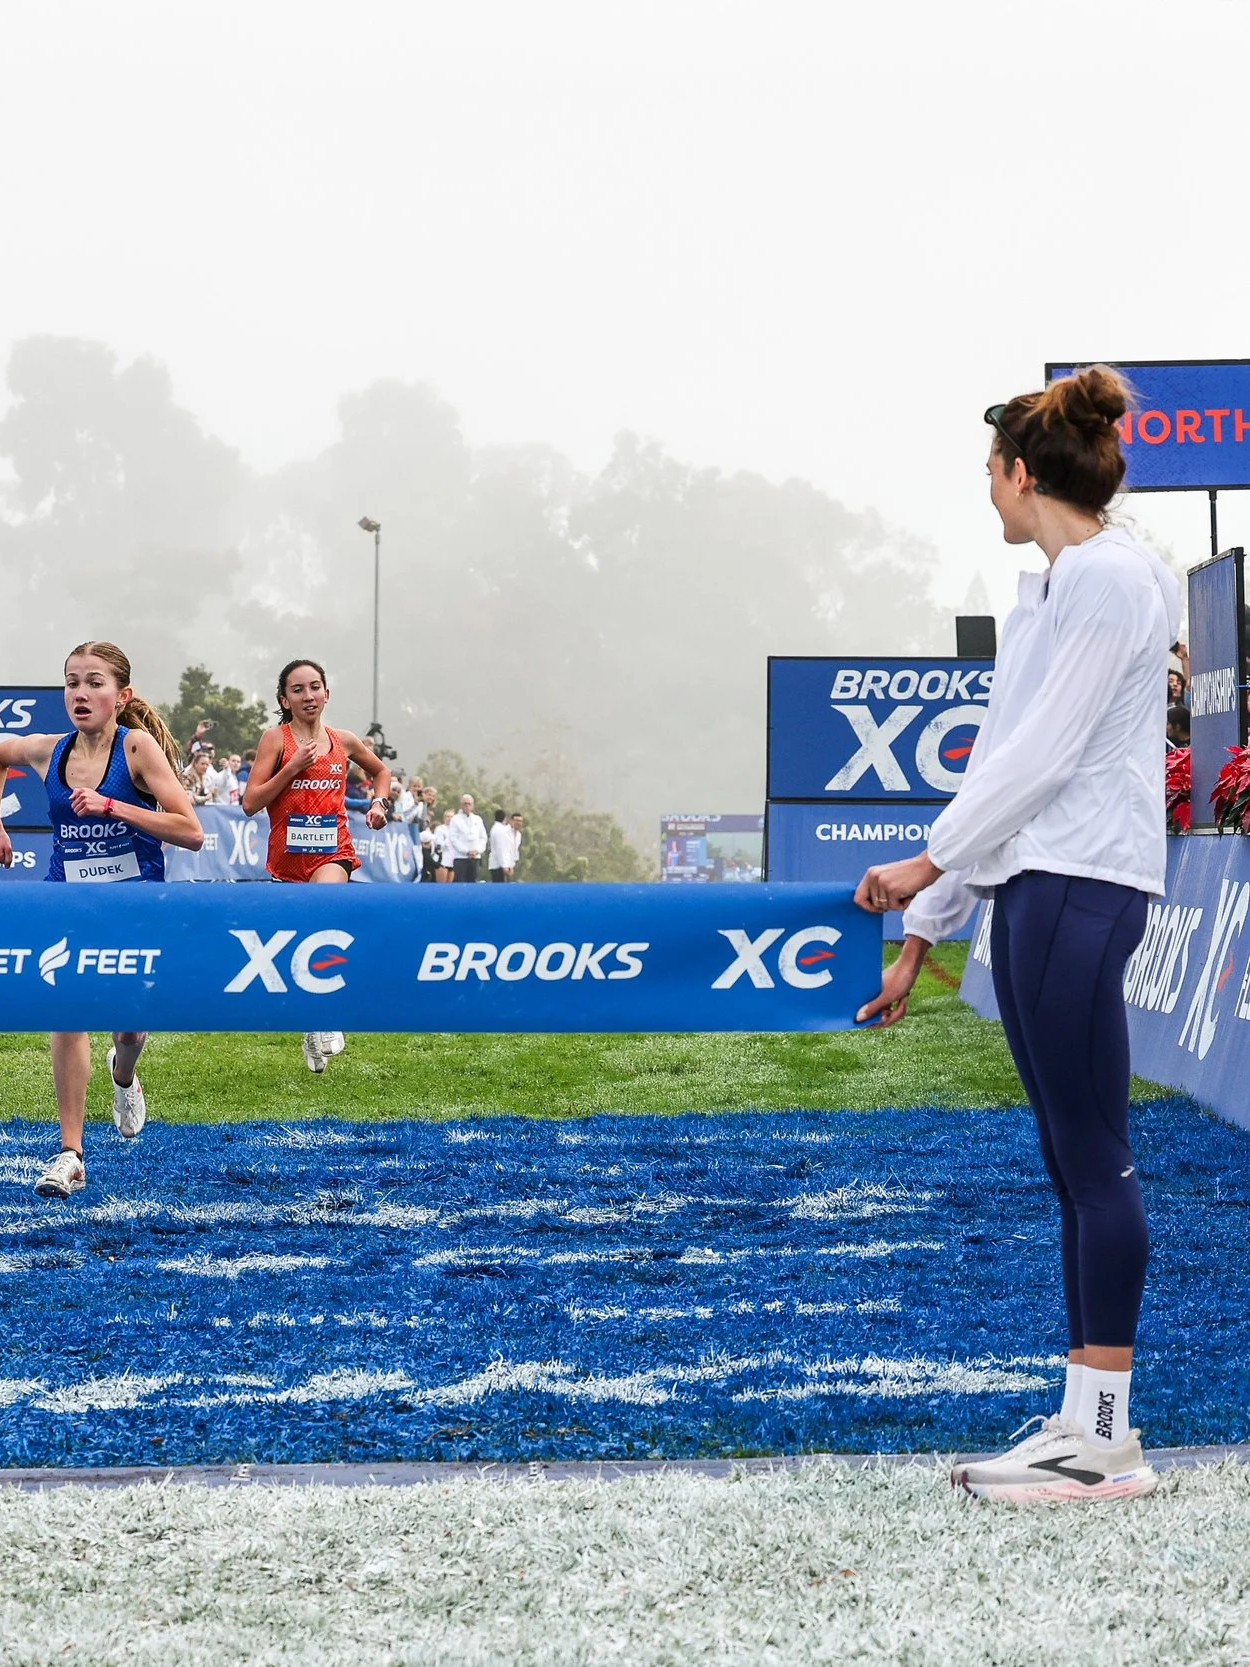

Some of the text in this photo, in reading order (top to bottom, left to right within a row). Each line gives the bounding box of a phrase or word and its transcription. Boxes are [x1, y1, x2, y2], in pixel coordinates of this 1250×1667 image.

[824, 704, 990, 793] XC
[291, 779, 342, 790] BROOKS
[60, 820, 128, 839] BROOKS
[305, 815, 322, 825] XC
[229, 820, 259, 865] XC
[291, 833, 334, 841] BARTLETT
[85, 841, 107, 854] XC
[79, 863, 124, 878] DUDEK
[77, 948, 162, 974] FEET
[223, 929, 355, 994] XC
[417, 942, 650, 981] BROOKS
[710, 925, 843, 989] XC
[1178, 878, 1250, 1065] XC
[1096, 1391, 1115, 1441] BROOKS
